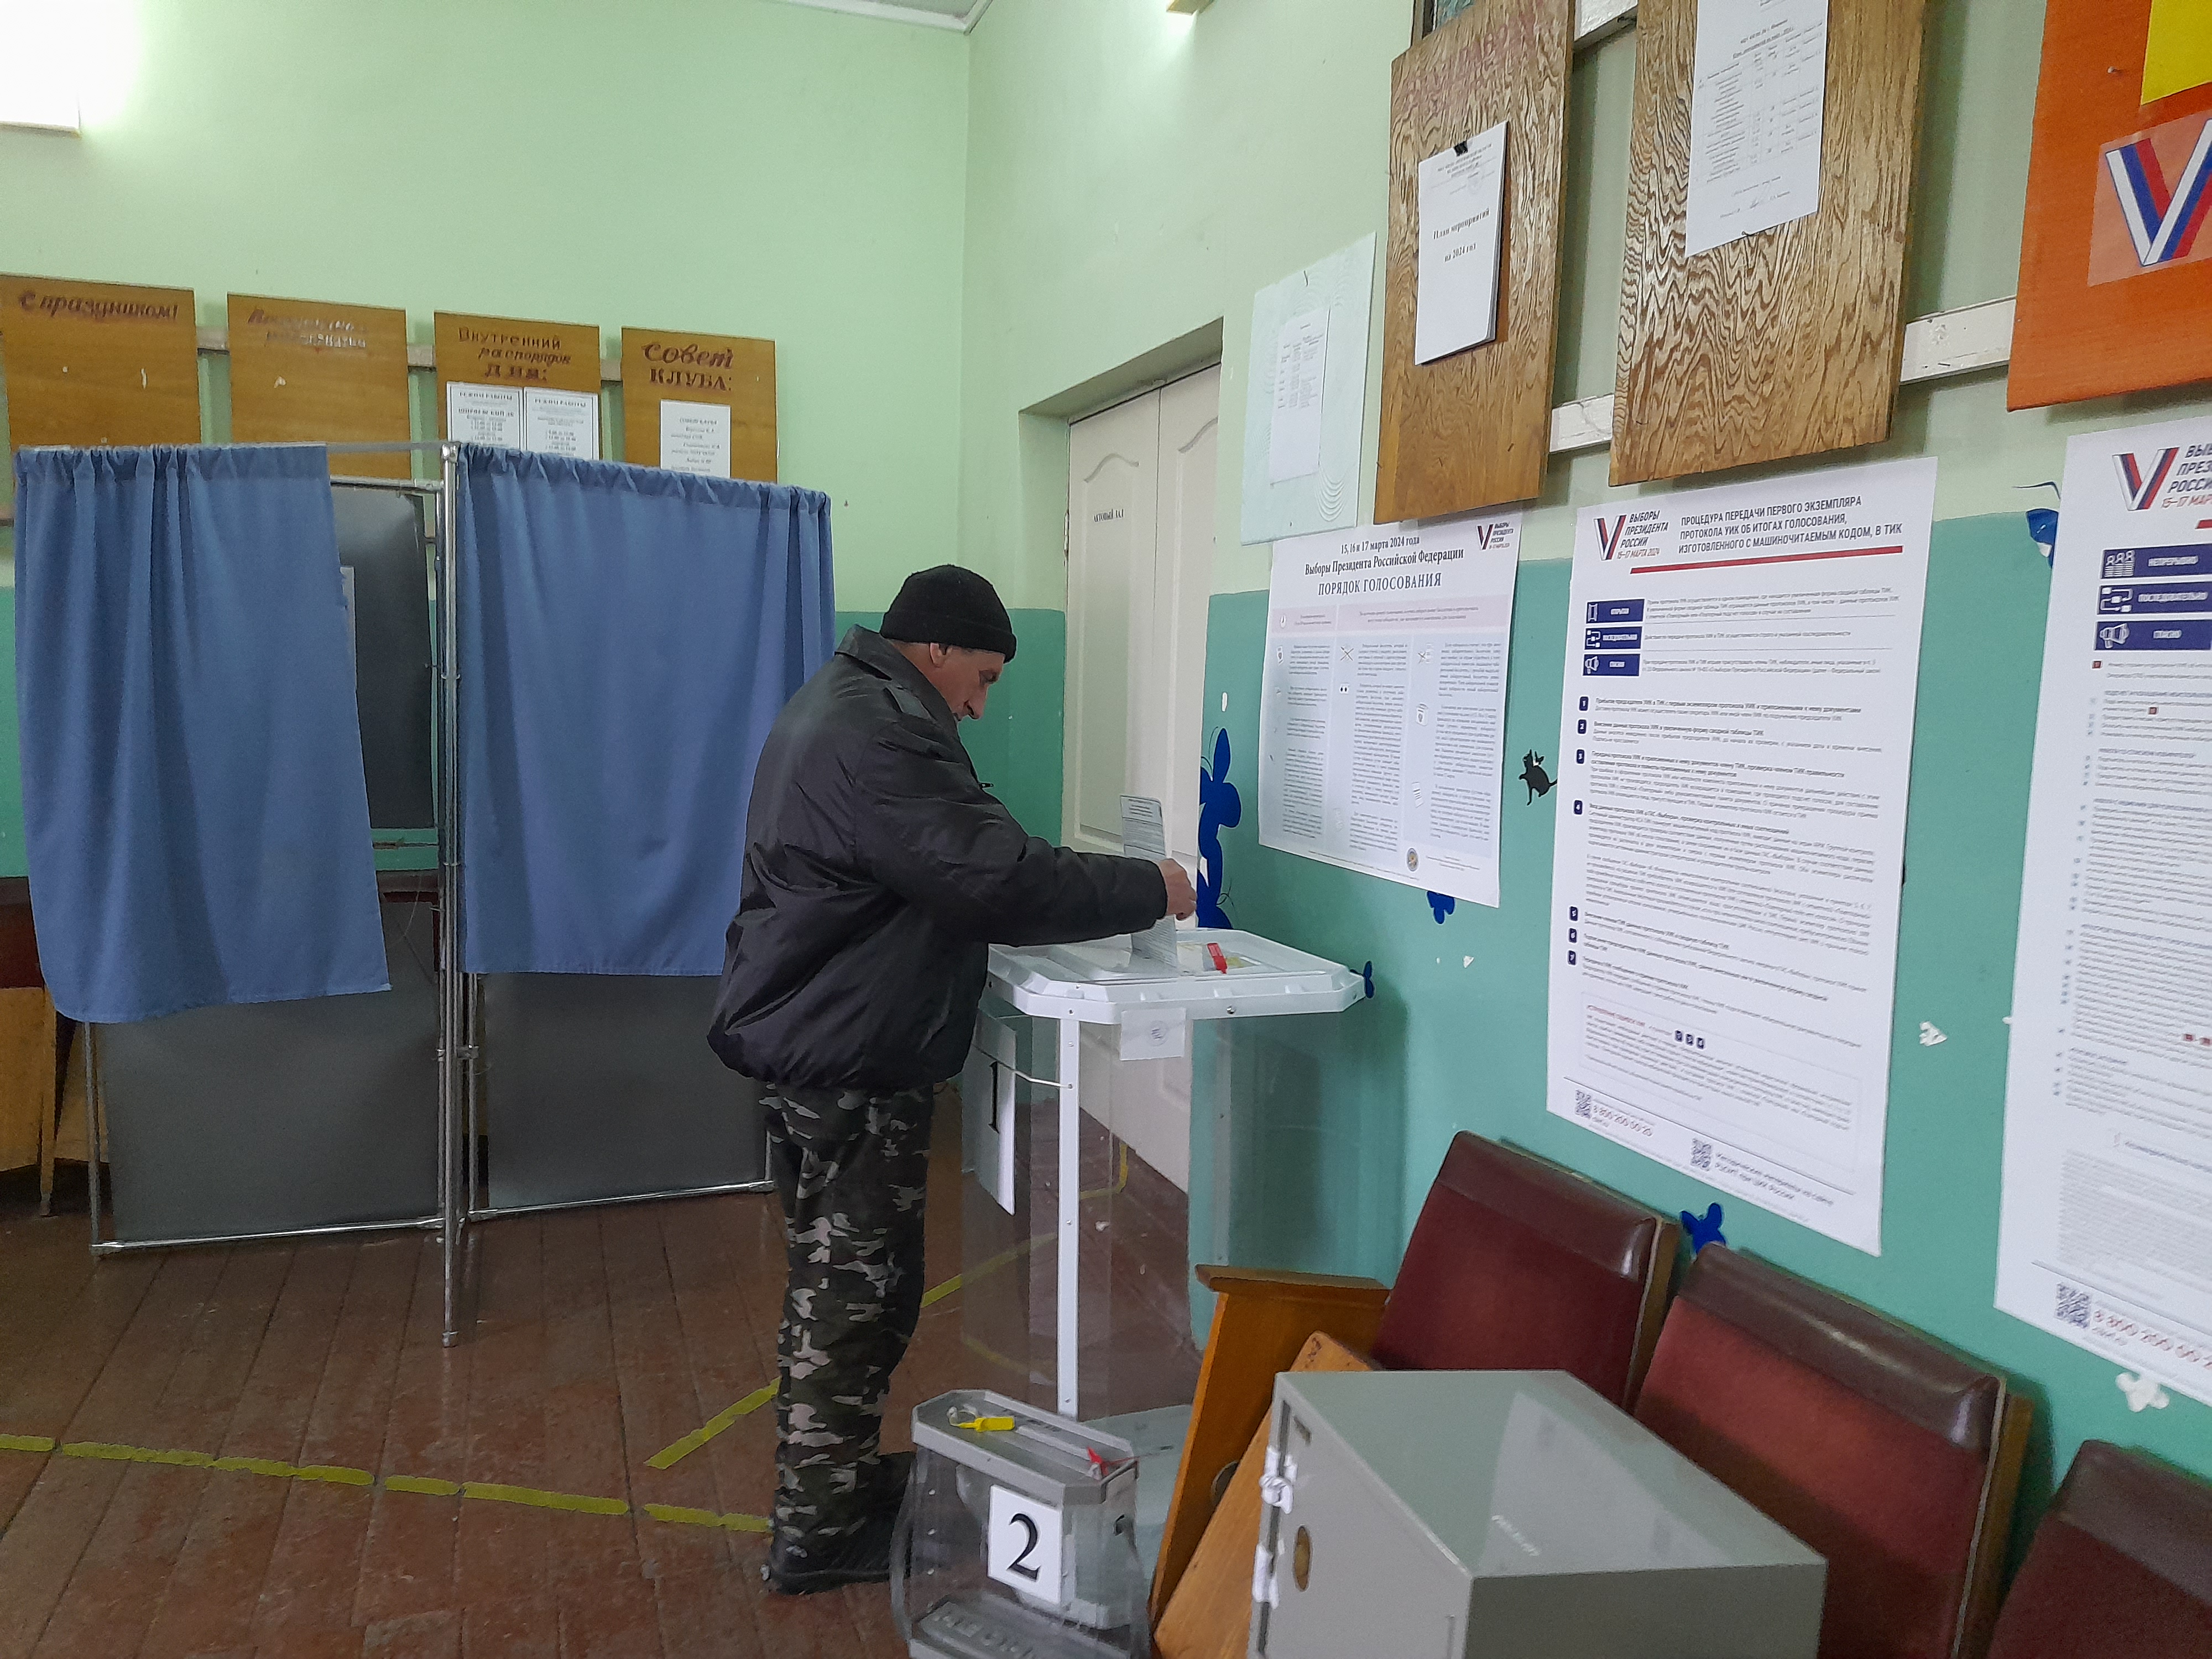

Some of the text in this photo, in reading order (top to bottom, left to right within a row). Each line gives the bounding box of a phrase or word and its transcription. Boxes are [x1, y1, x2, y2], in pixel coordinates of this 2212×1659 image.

[1453, 246, 1465, 259] 2024
[458, 327, 561, 349] Внутренний
[641, 342, 733, 368] Совет
[1629, 510, 1661, 523] ВЫБОРЫ
[1681, 496, 1861, 526] ПРОЦЕДУРА ПЕРЕДАЧИ ПЕРВОГО ЭКЗЕМПЛЯРА
[1625, 521, 1669, 536] ПРЕЗИДЕНТА
[1679, 523, 1902, 554] ИЗГОТОВЛЕННОГО С МАШИНОЧИТАЕМЫМ КОДОМ, В ТИК
[1680, 514, 1847, 540] ПРОТОКОЛА УИК ОБ ИТОГАХ ГОЛОСОВАНИЯ,
[1350, 543, 1355, 553] 16
[1362, 541, 1369, 551] 17
[1370, 541, 1389, 552] марта
[1390, 536, 1405, 548] 2024
[1406, 536, 1420, 547] года
[1620, 536, 1648, 548] РОССИИ
[1305, 549, 1464, 577] Выборы Президента Российской Федерации
[1318, 572, 1442, 596] ПОРЯДОК ГОЛОСОВАНИЯ
[1006, 1512, 1041, 1582] 2
